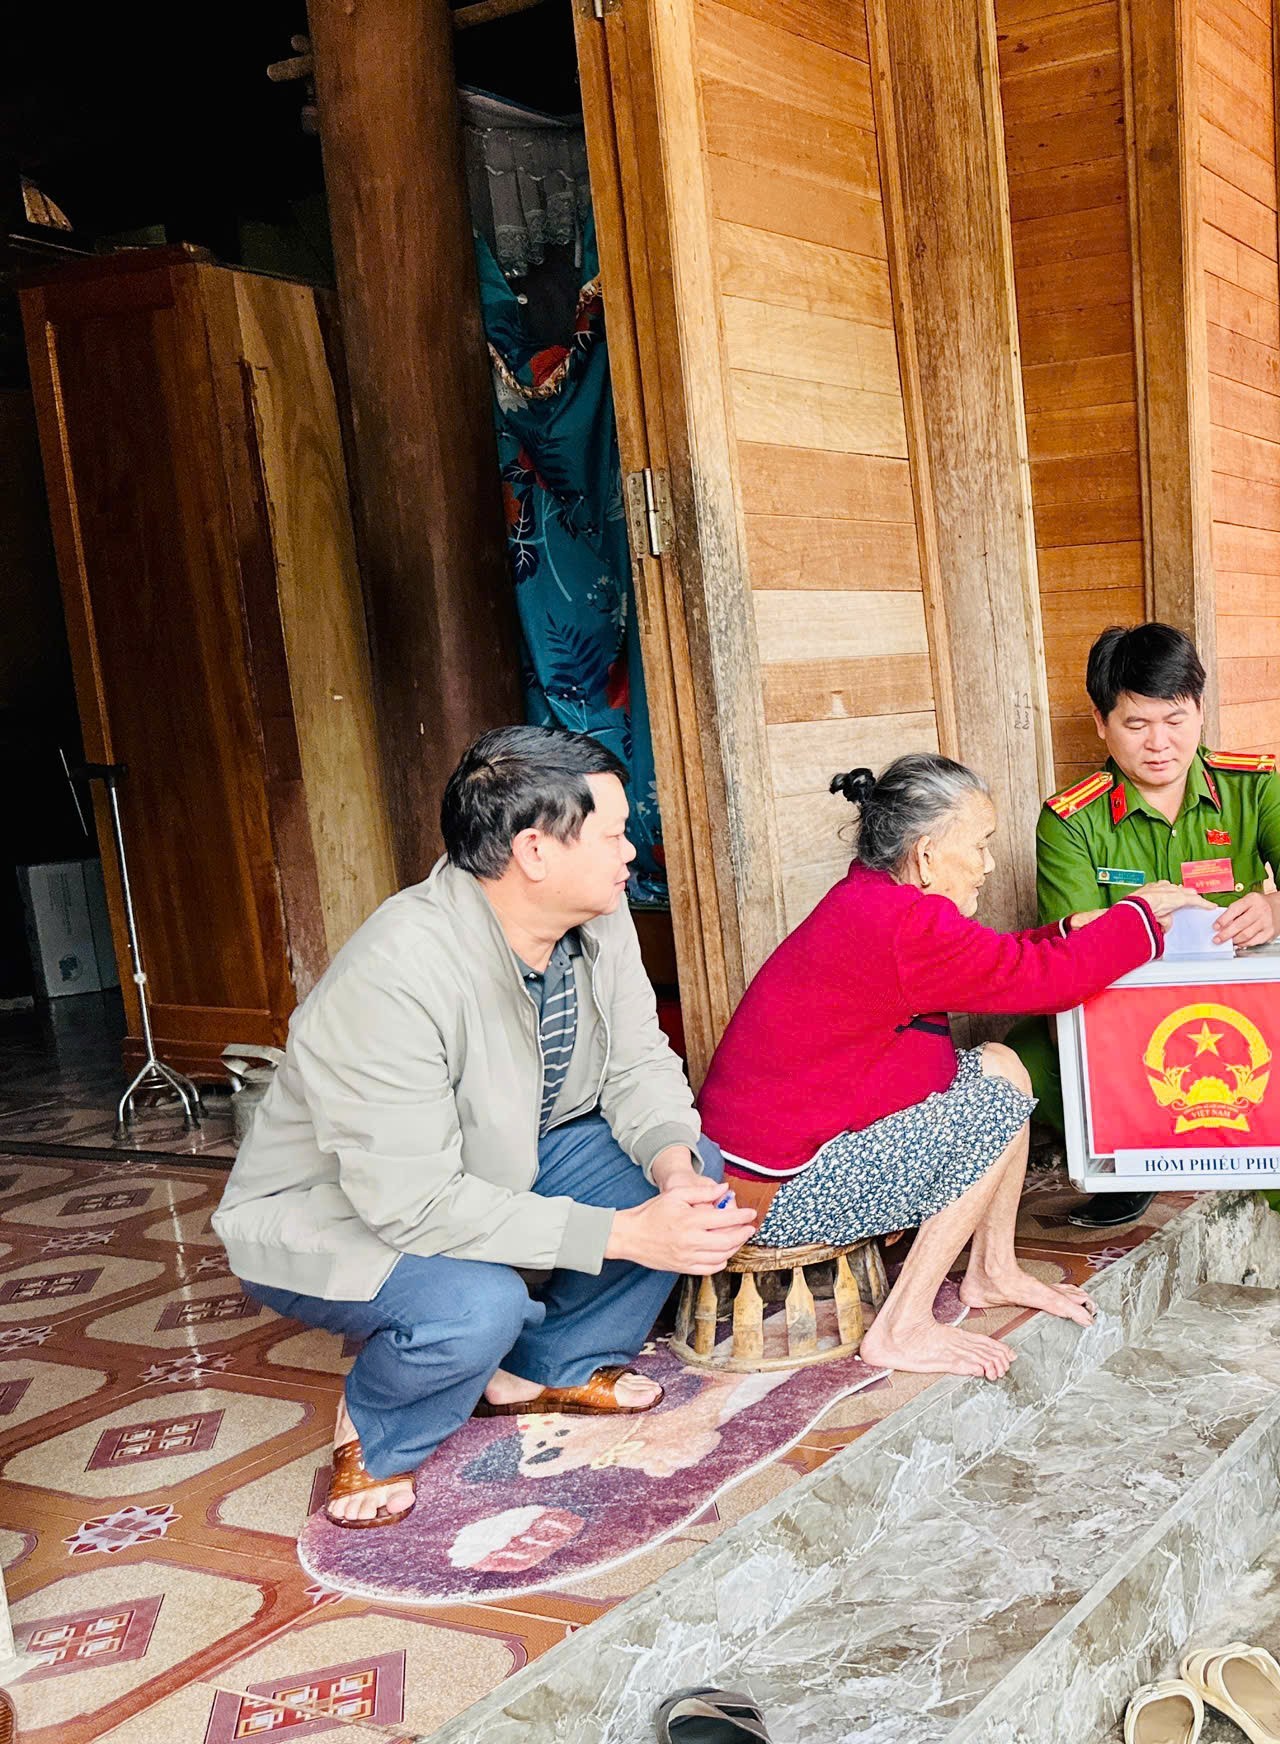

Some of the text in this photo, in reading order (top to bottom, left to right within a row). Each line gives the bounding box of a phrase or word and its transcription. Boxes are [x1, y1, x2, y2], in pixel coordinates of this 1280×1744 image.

[1145, 1154, 1280, 1173] HÒM PHIẾU PHỤ
